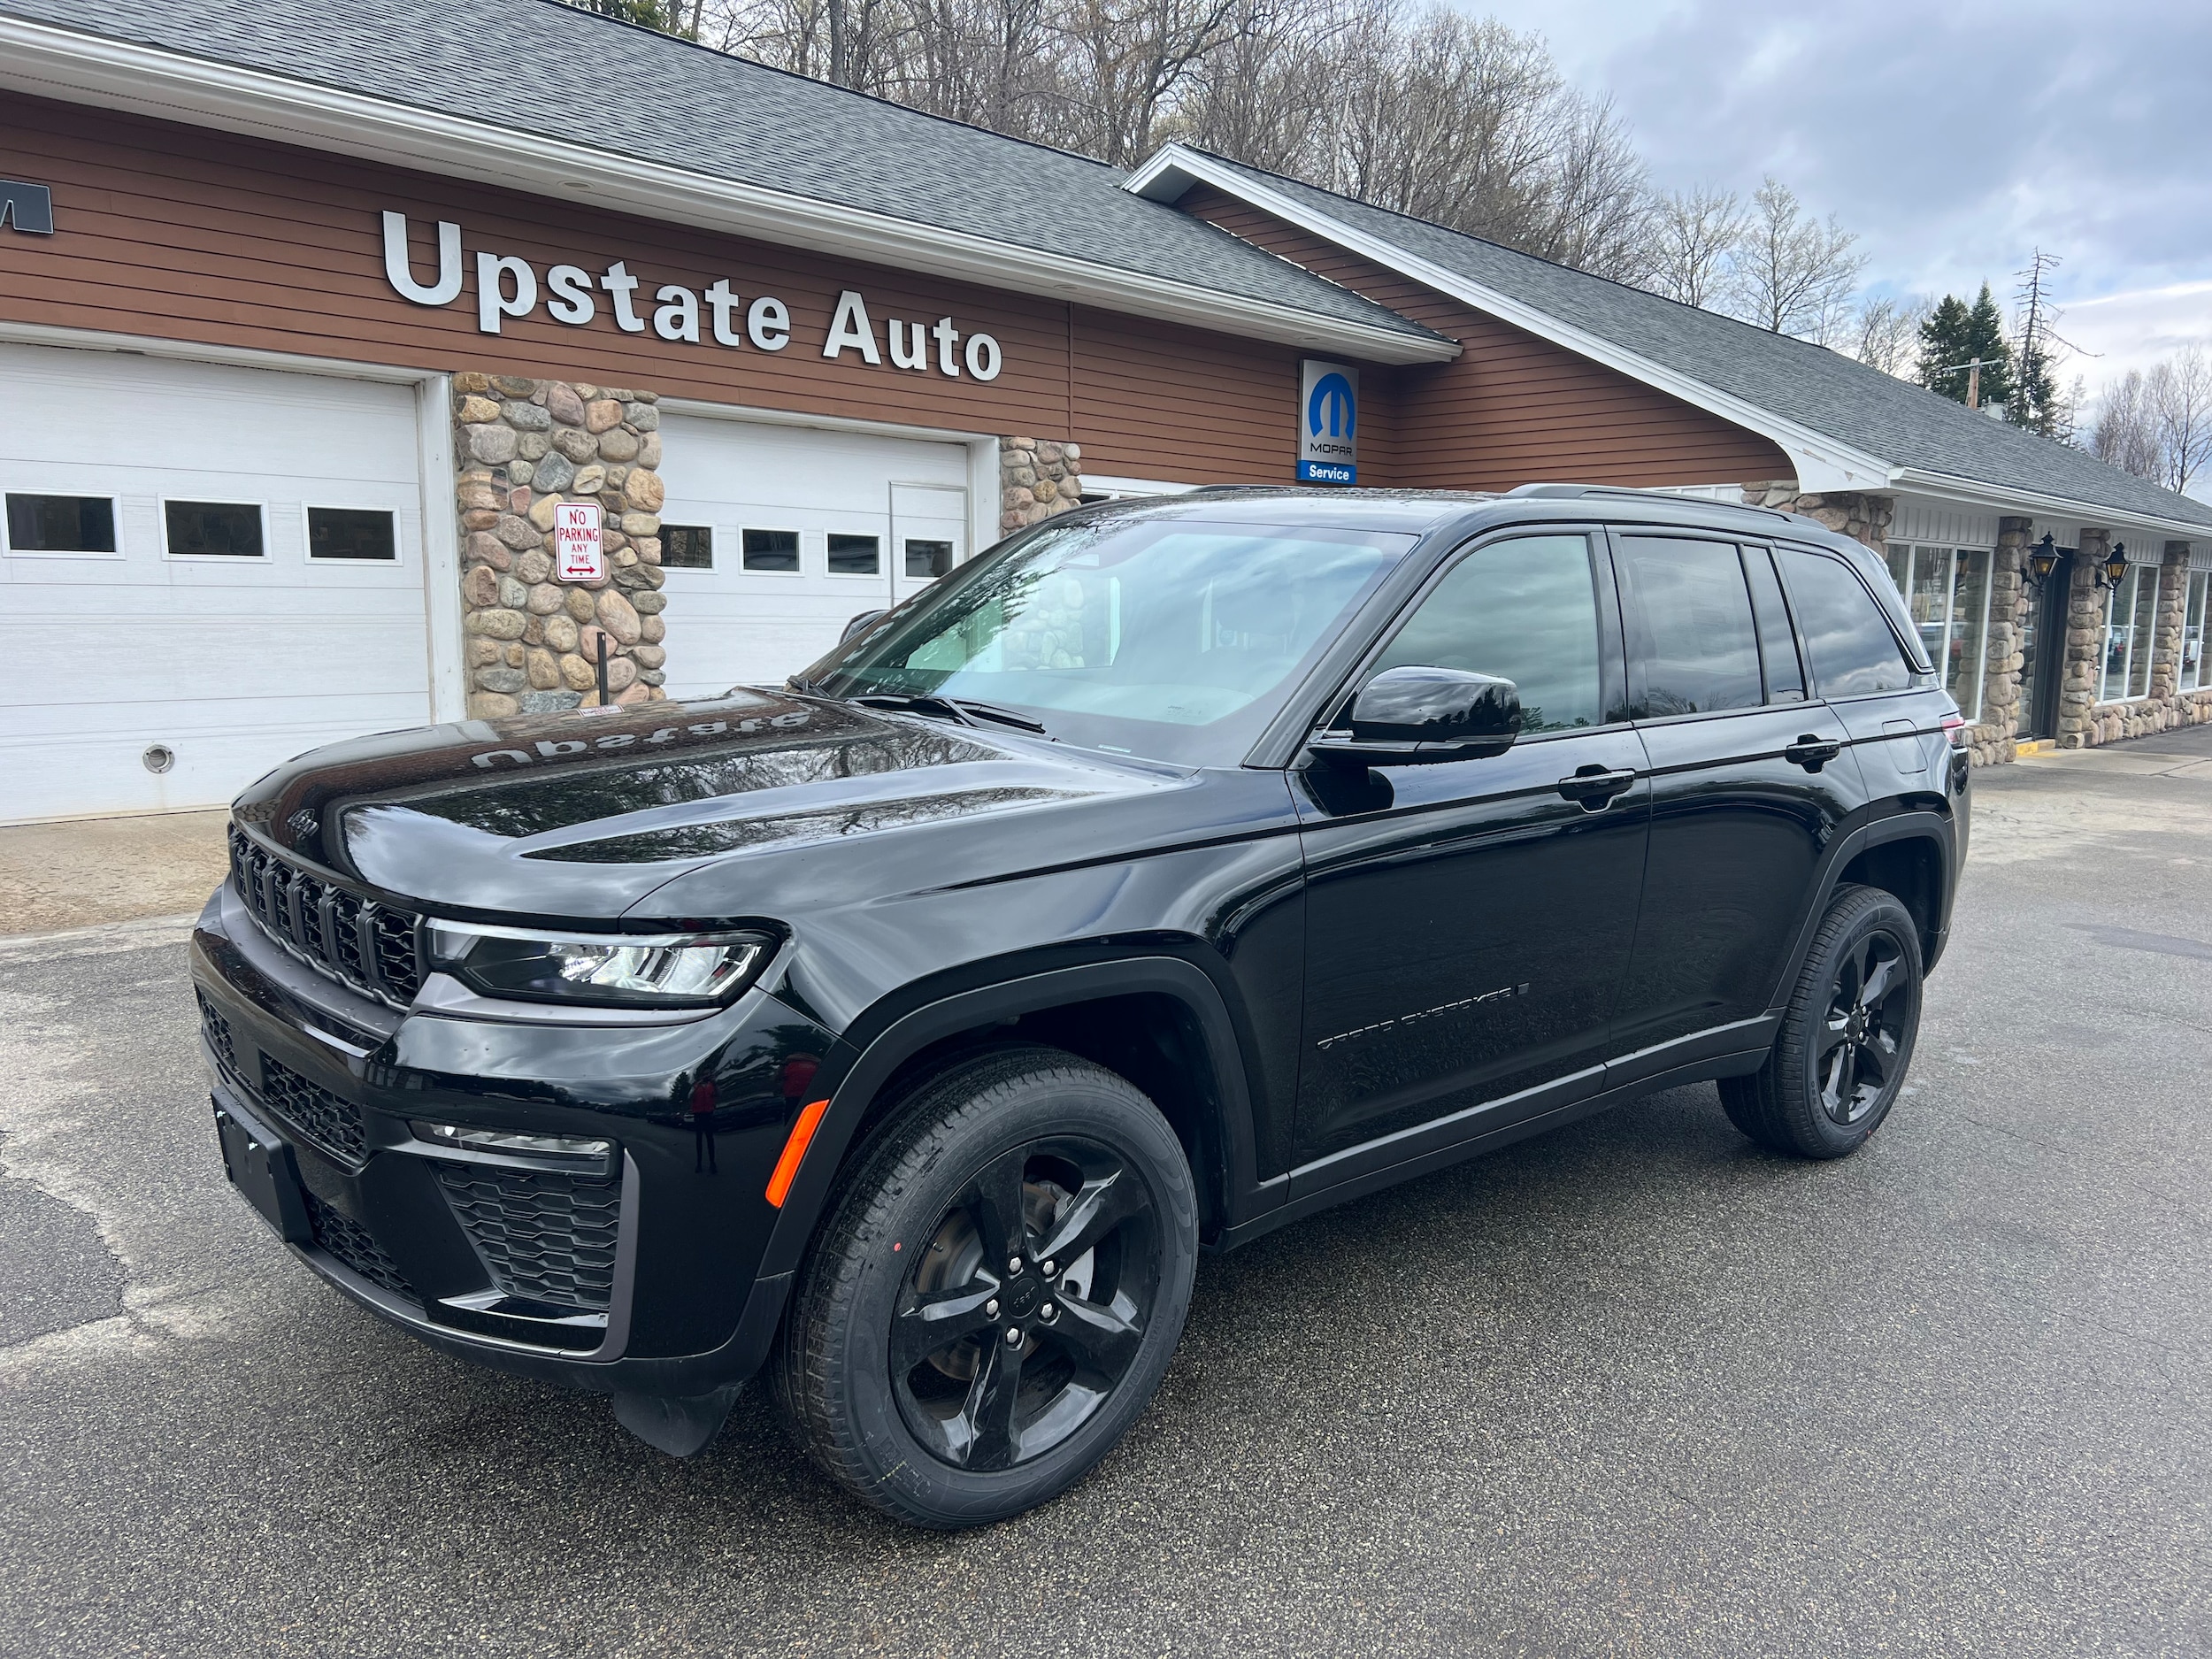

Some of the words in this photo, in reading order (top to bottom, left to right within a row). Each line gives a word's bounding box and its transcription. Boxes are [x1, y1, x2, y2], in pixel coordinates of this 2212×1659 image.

[381, 210, 791, 351] Upstate
[822, 289, 1002, 382] Auto
[1310, 443, 1352, 456] MOPAR
[1309, 465, 1349, 480] Service
[569, 511, 586, 525] NO
[559, 527, 598, 541] PARKING
[572, 543, 588, 552] ANY
[571, 554, 590, 564] TIME
